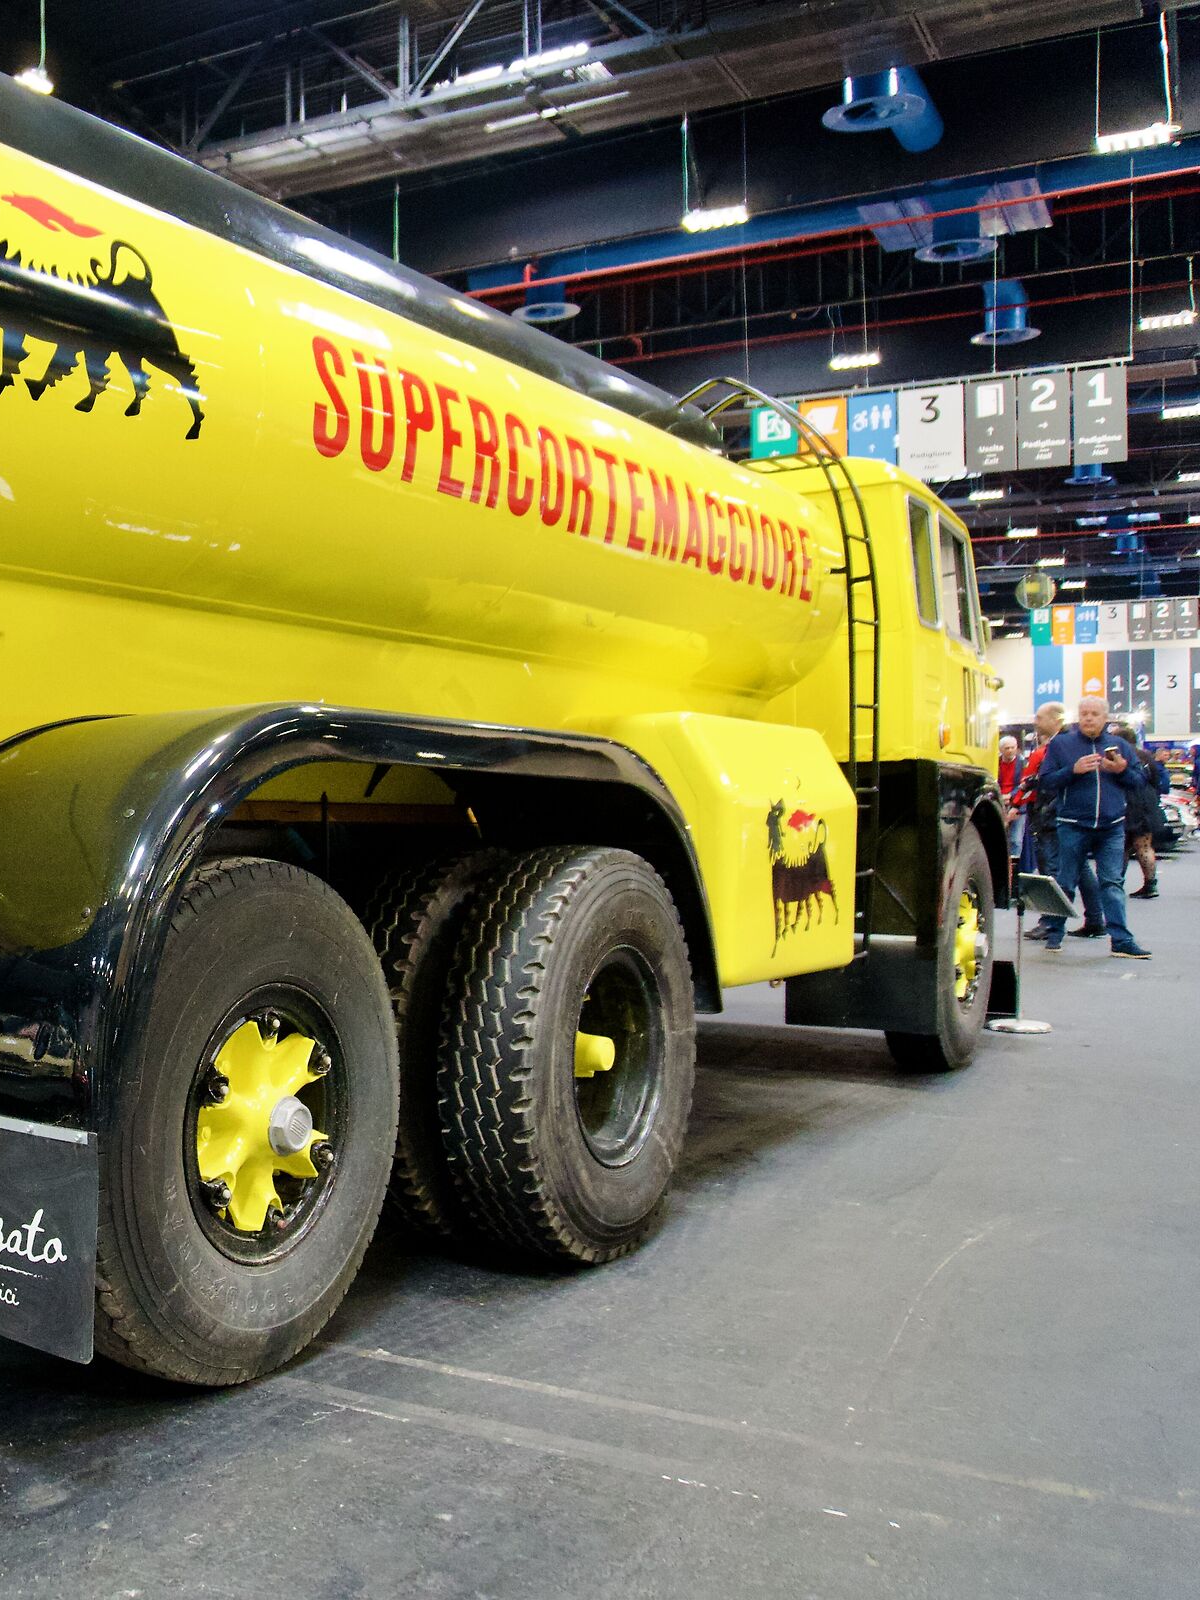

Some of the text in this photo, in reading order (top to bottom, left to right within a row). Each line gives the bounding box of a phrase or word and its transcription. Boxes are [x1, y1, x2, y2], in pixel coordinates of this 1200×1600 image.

[1030, 378, 1057, 412] 2
[1087, 372, 1112, 407] 1
[920, 394, 941, 423] 3
[1021, 437, 1066, 449] Padiglione
[1078, 433, 1122, 445] Padiglione
[313, 335, 812, 601] SUPERCORTEMAGGIORE
[1107, 606, 1118, 619] 3
[1156, 603, 1169, 618] 2
[1180, 601, 1193, 617] 1
[1111, 674, 1124, 692] 1
[1136, 674, 1150, 691] 2
[1166, 674, 1177, 689] 3
